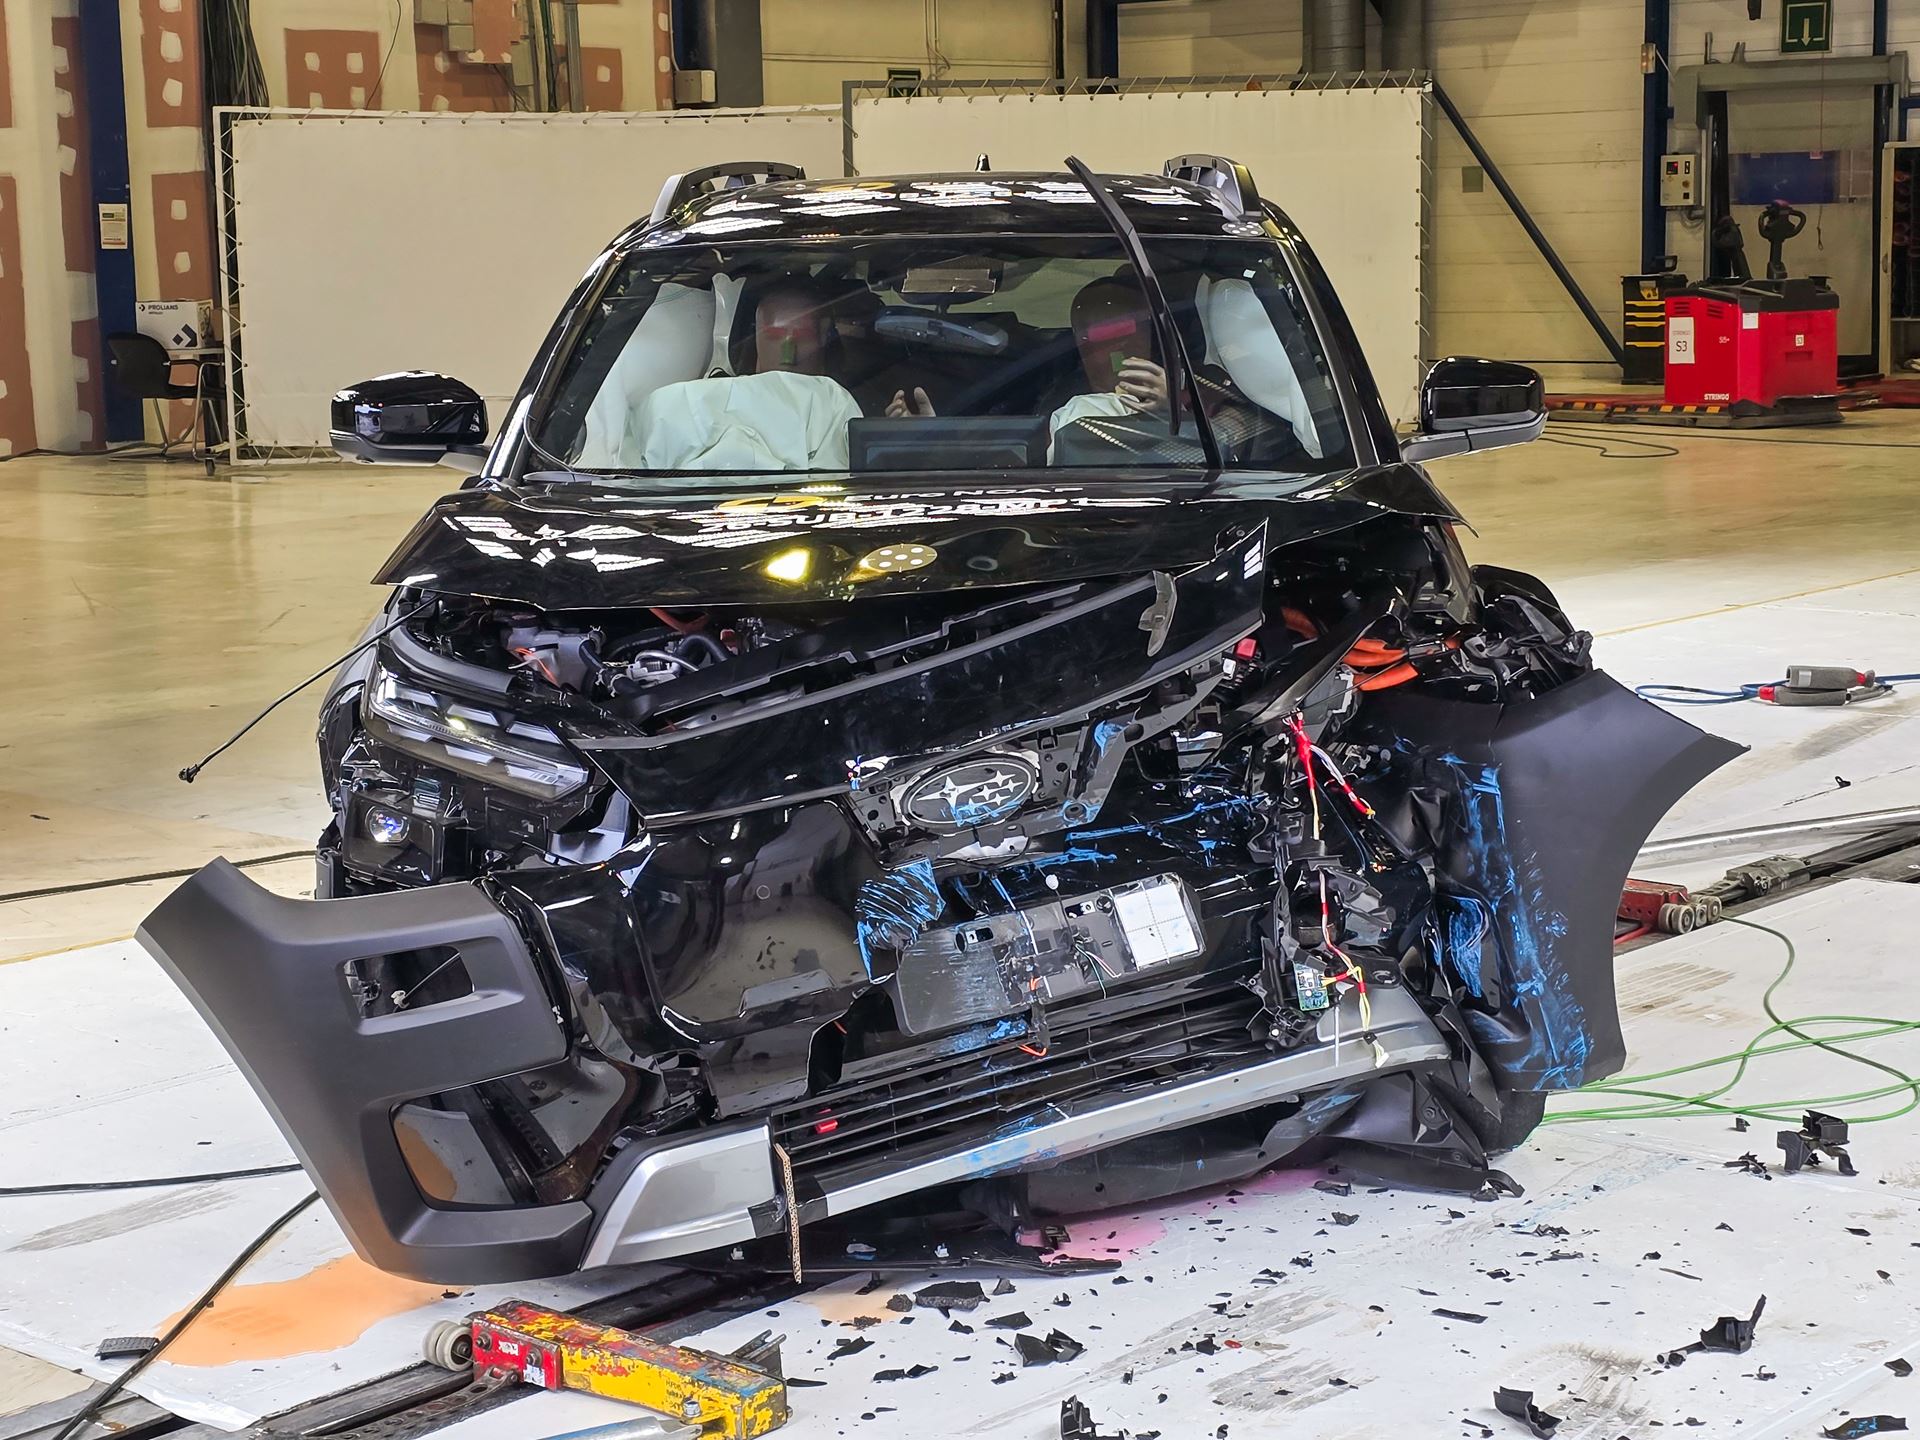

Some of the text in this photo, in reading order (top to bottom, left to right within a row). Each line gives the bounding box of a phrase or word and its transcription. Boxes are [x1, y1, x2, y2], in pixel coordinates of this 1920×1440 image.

[1676, 340, 1688, 352] S3
[1704, 393, 1730, 401] STRINGO
[843, 492, 946, 503] Euro
